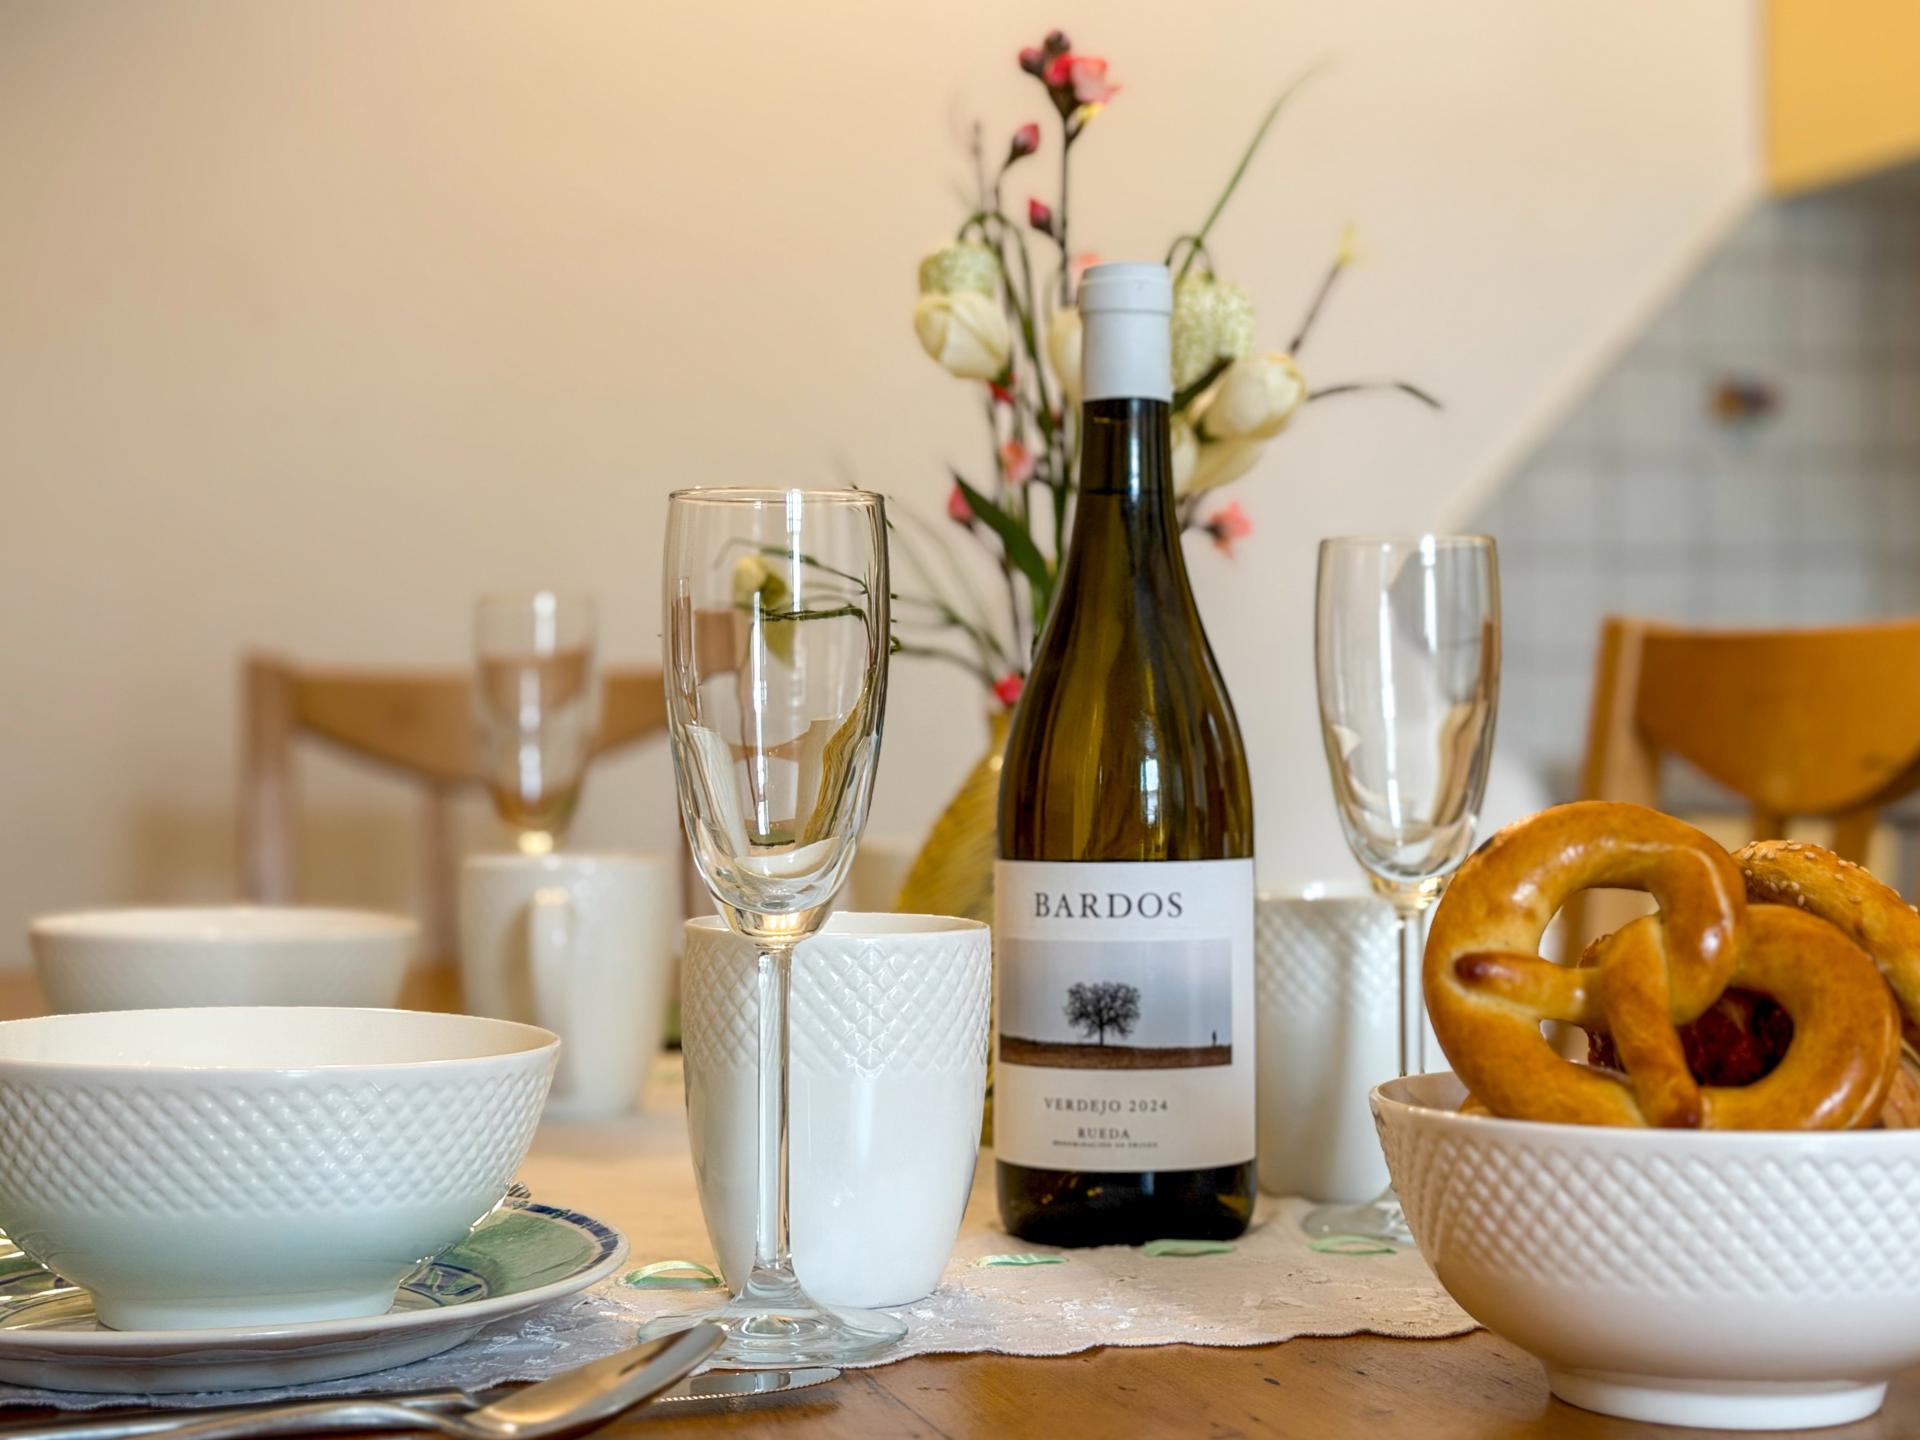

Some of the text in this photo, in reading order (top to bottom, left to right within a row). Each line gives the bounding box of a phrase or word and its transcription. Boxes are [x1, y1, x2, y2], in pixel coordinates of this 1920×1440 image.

[1034, 892, 1183, 918] BARDOS
[1044, 1097, 1168, 1115] VERDEJO 2024
[1078, 1128, 1130, 1139] RUEDA
